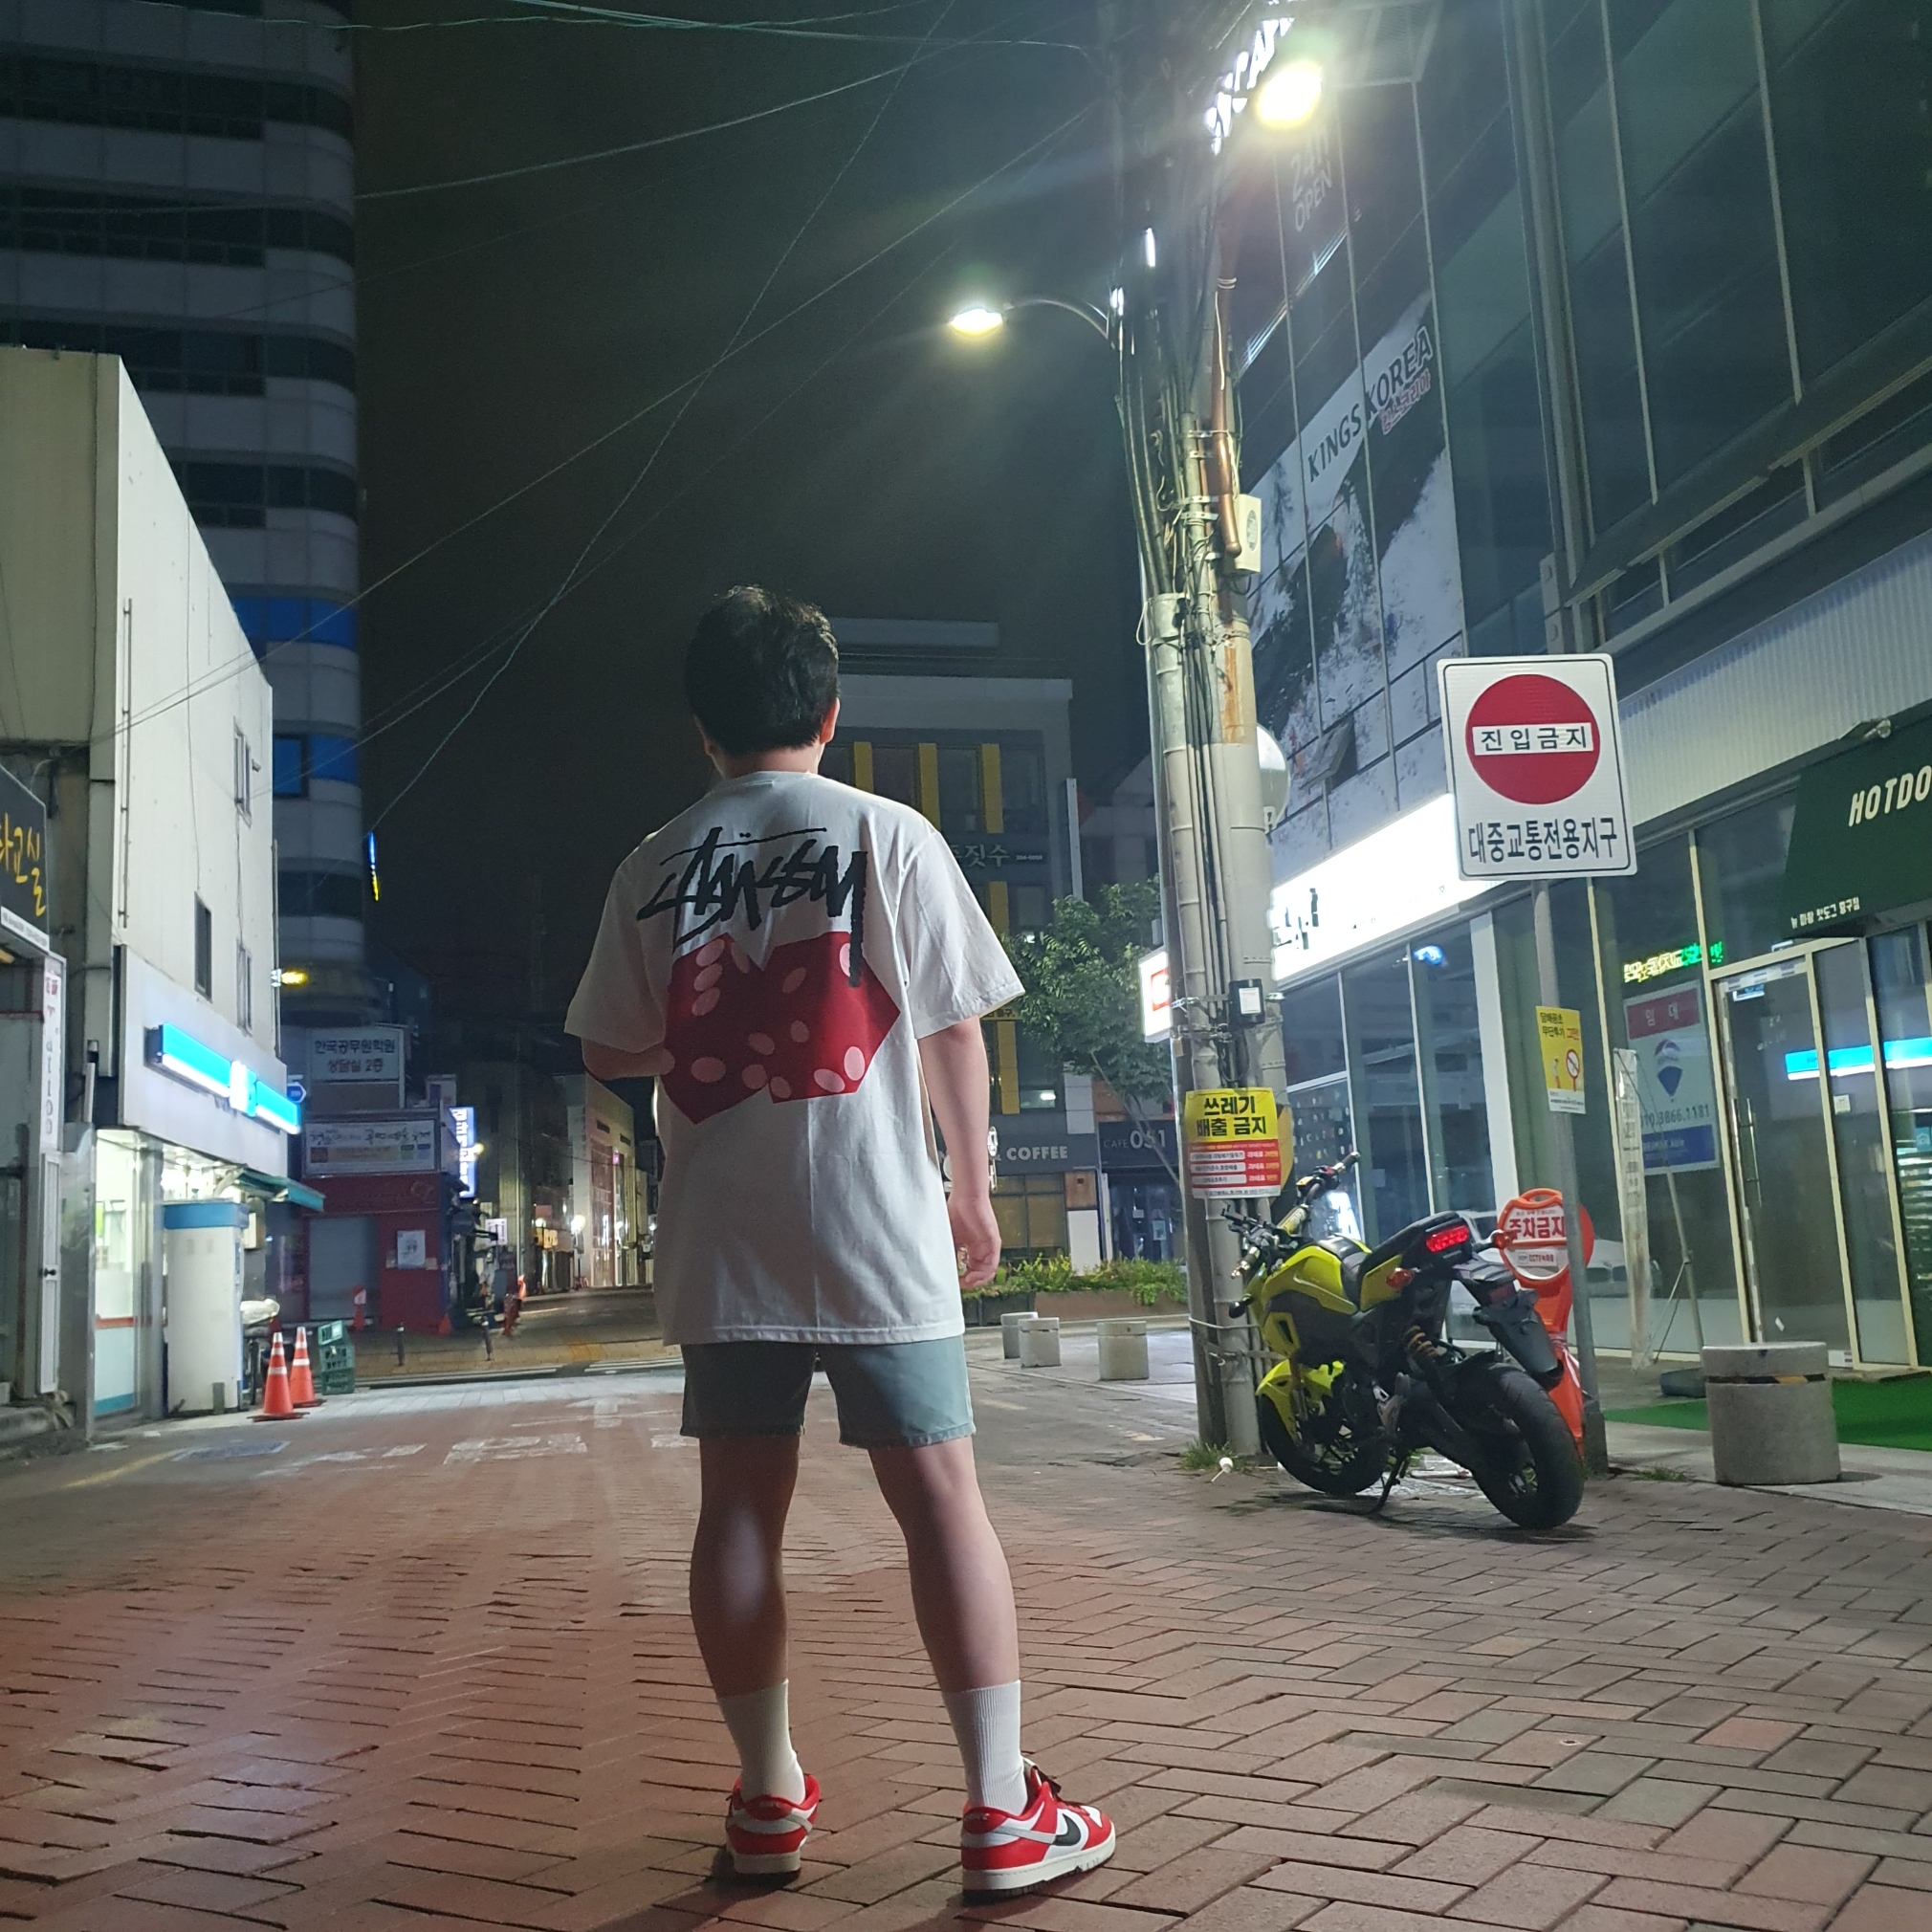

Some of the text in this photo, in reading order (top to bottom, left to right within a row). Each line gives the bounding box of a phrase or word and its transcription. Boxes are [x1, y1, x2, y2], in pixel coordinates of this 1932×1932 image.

[1295, 160, 1332, 232] OPEN
[1307, 328, 1433, 483] KINGS KOREA
[1481, 725, 1588, 752] 진입금지
[1467, 816, 1618, 865] 대중교통전용지구
[314, 1039, 396, 1054] 한국공무원학원
[1204, 1095, 1256, 1116] 쓰레기
[1197, 1116, 1266, 1136] 배출 금지
[1006, 1145, 1068, 1160] COFFEE
[1103, 1138, 1129, 1149] CAFE
[1509, 1216, 1566, 1240] 주차금지
